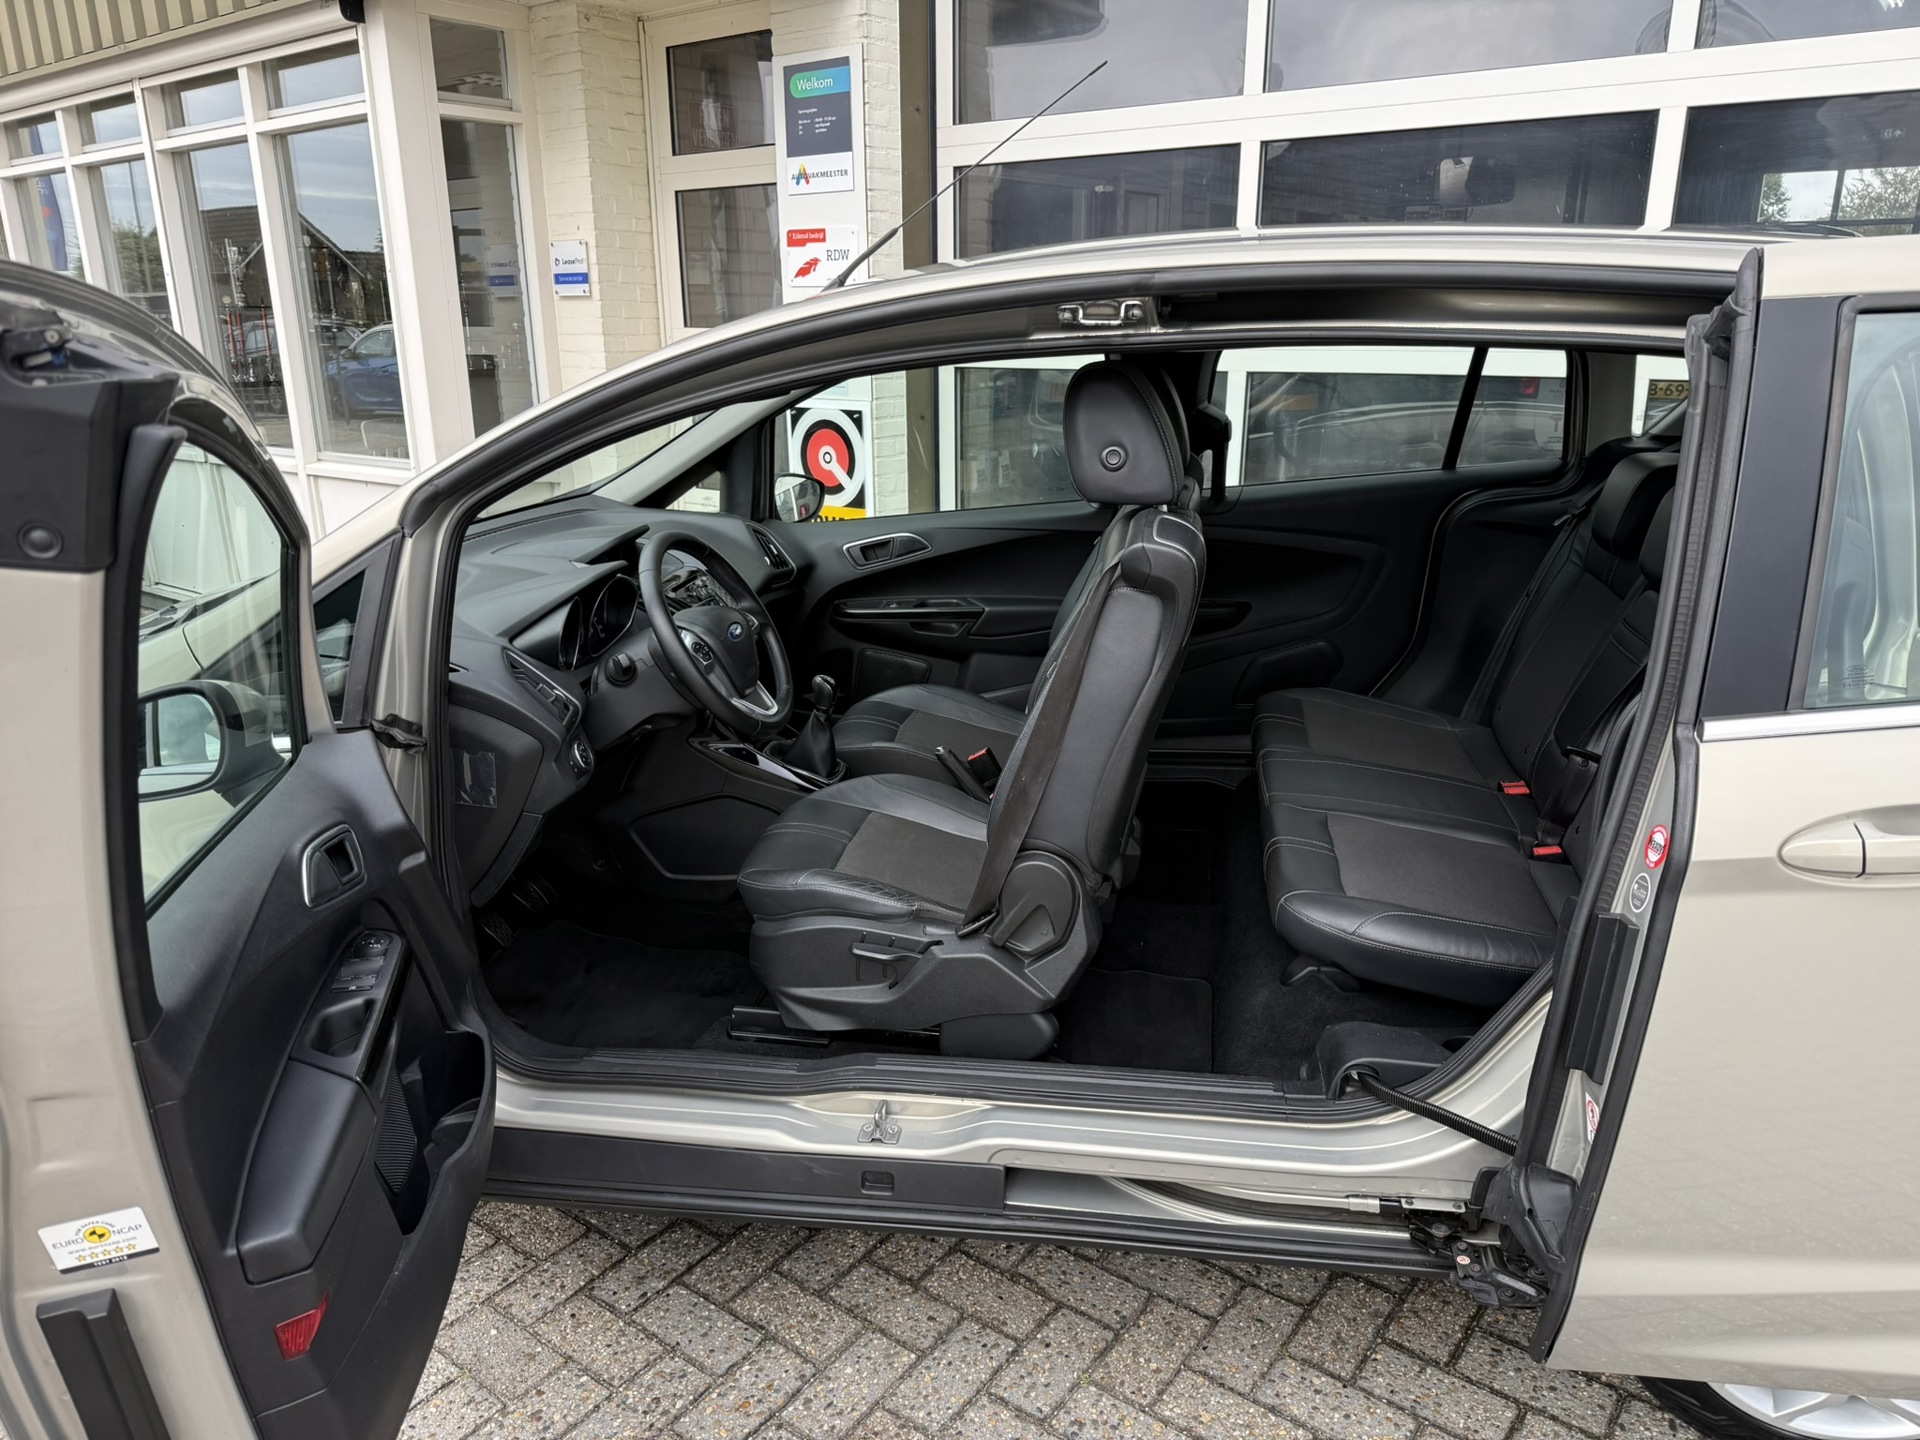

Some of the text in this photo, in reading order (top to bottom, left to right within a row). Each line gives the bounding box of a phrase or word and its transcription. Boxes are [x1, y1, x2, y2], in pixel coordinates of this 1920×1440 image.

[797, 77, 833, 91] Welkom
[826, 249, 850, 261] RDW
[51, 1223, 142, 1250] EURO NCAP
